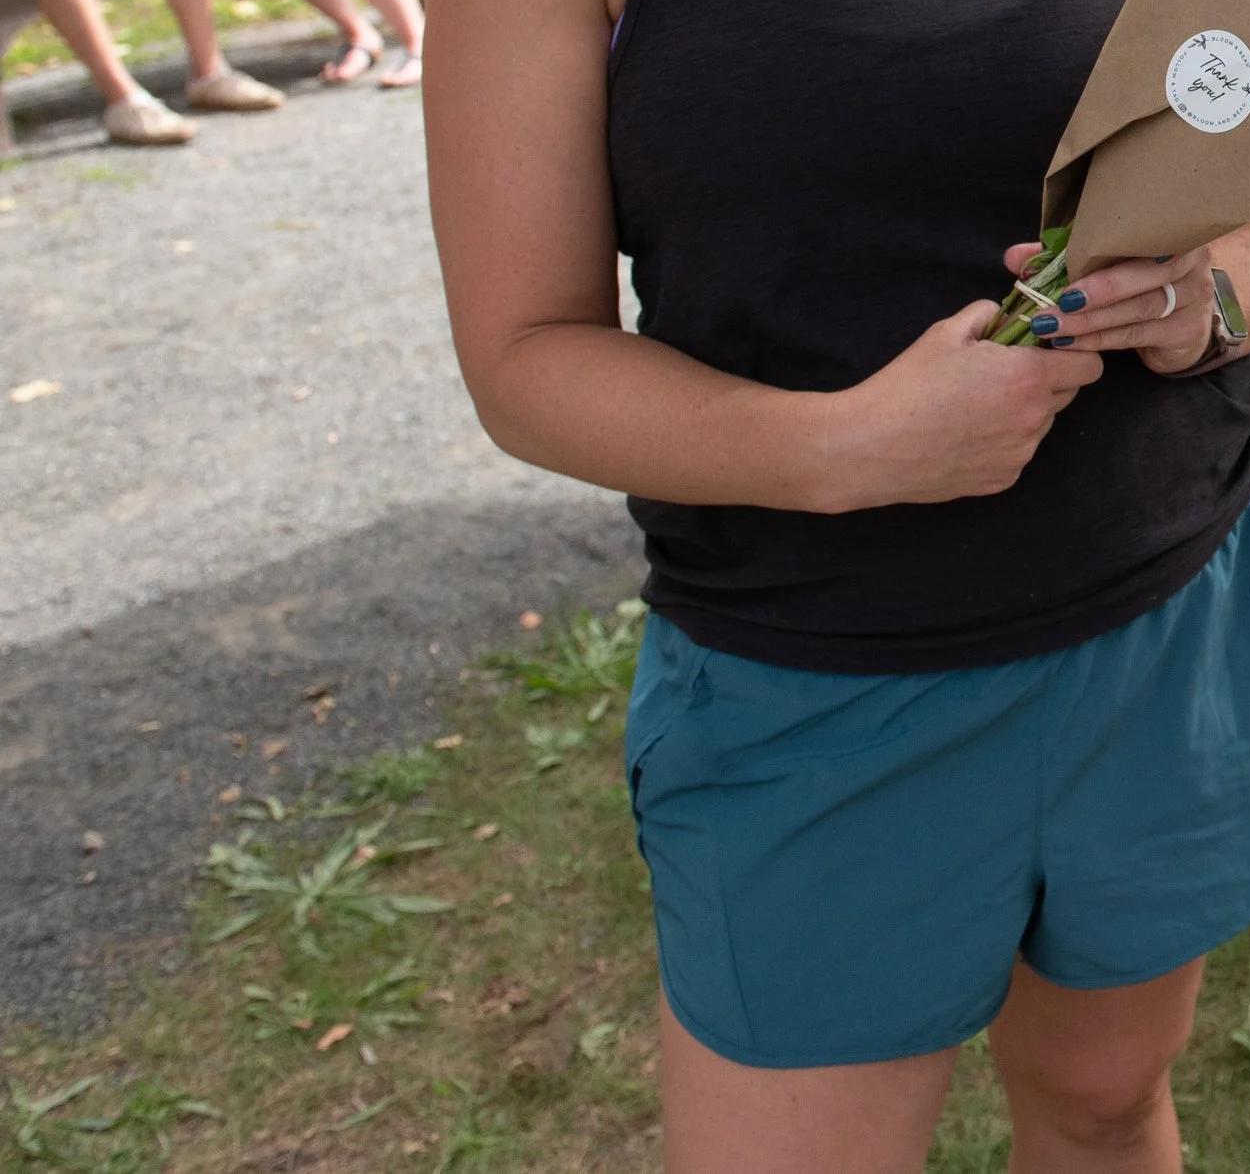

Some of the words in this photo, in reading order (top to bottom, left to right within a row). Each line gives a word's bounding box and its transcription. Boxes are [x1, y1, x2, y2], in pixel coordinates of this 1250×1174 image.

[1172, 52, 1187, 79] FOLLOW
[1212, 36, 1234, 46] BLOOM
[1239, 50, 1250, 68] BEAU
[1200, 53, 1239, 91] Thank
[1187, 78, 1226, 103] you!
